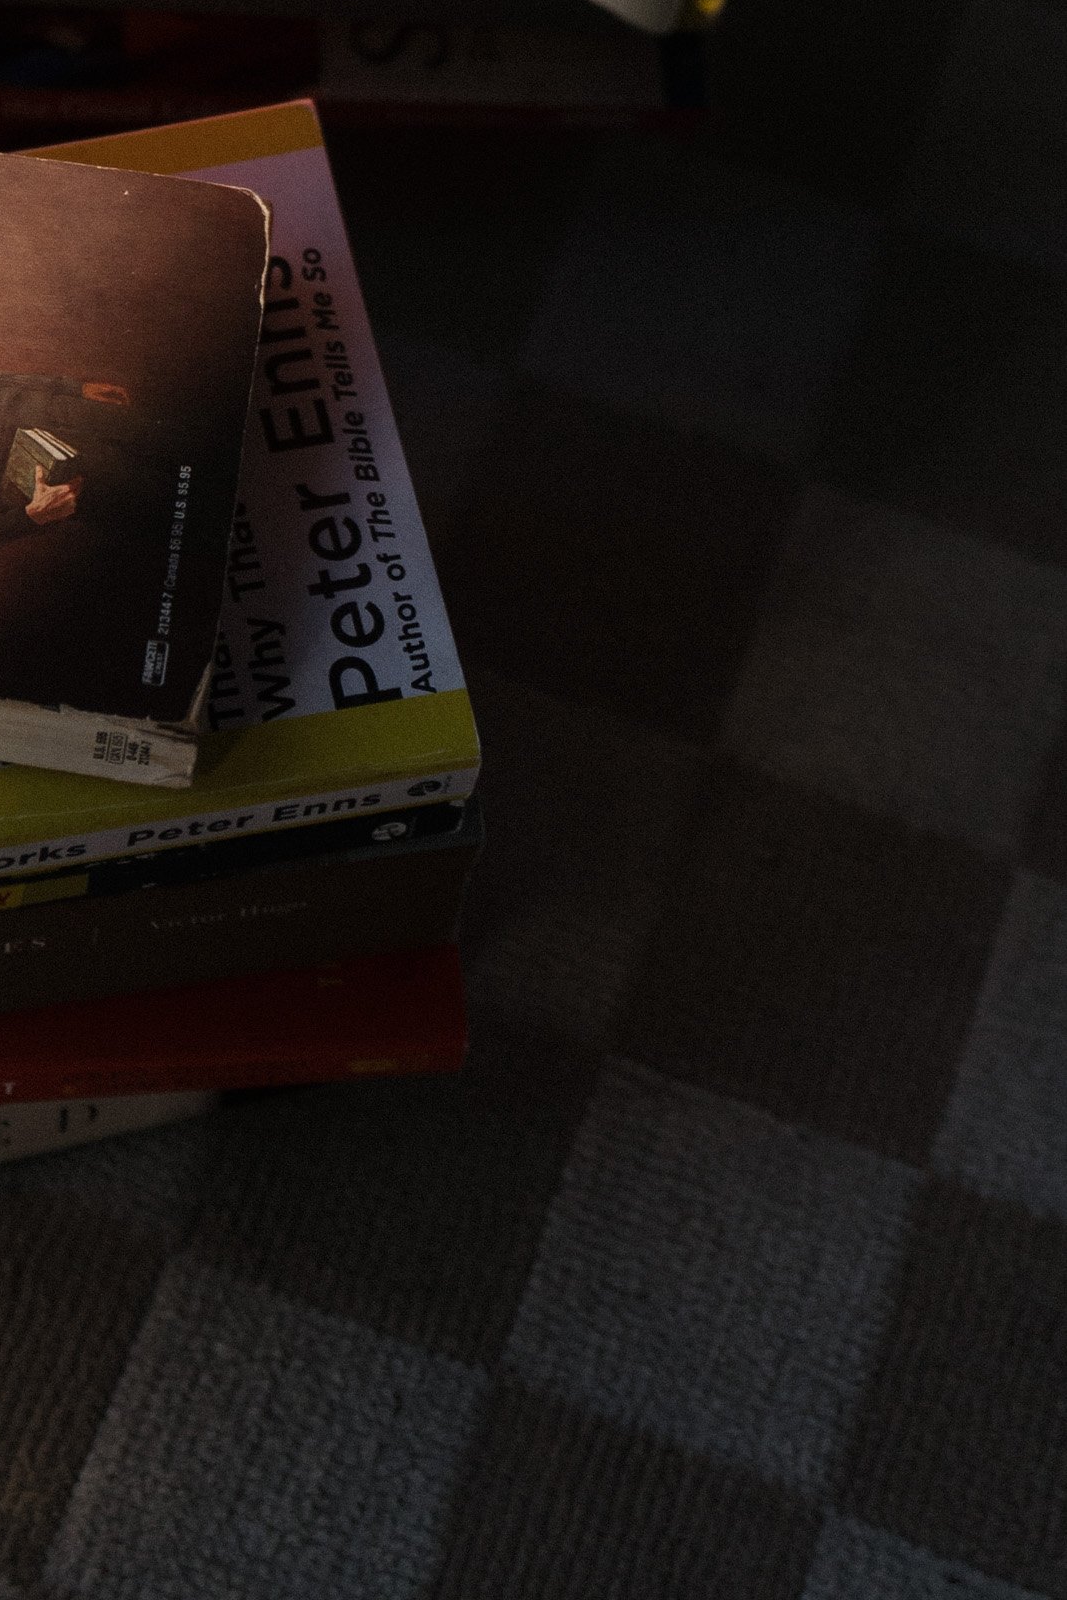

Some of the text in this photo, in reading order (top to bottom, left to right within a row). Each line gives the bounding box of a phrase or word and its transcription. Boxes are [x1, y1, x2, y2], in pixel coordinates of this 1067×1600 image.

[178, 464, 192, 496] $5.95
[256, 255, 405, 712] Peter Enns
[301, 246, 438, 697] Author of The Bible Tells Me So
[207, 630, 246, 733] Tha
[246, 614, 298, 724] Why
[126, 788, 383, 849] Peter Enns
